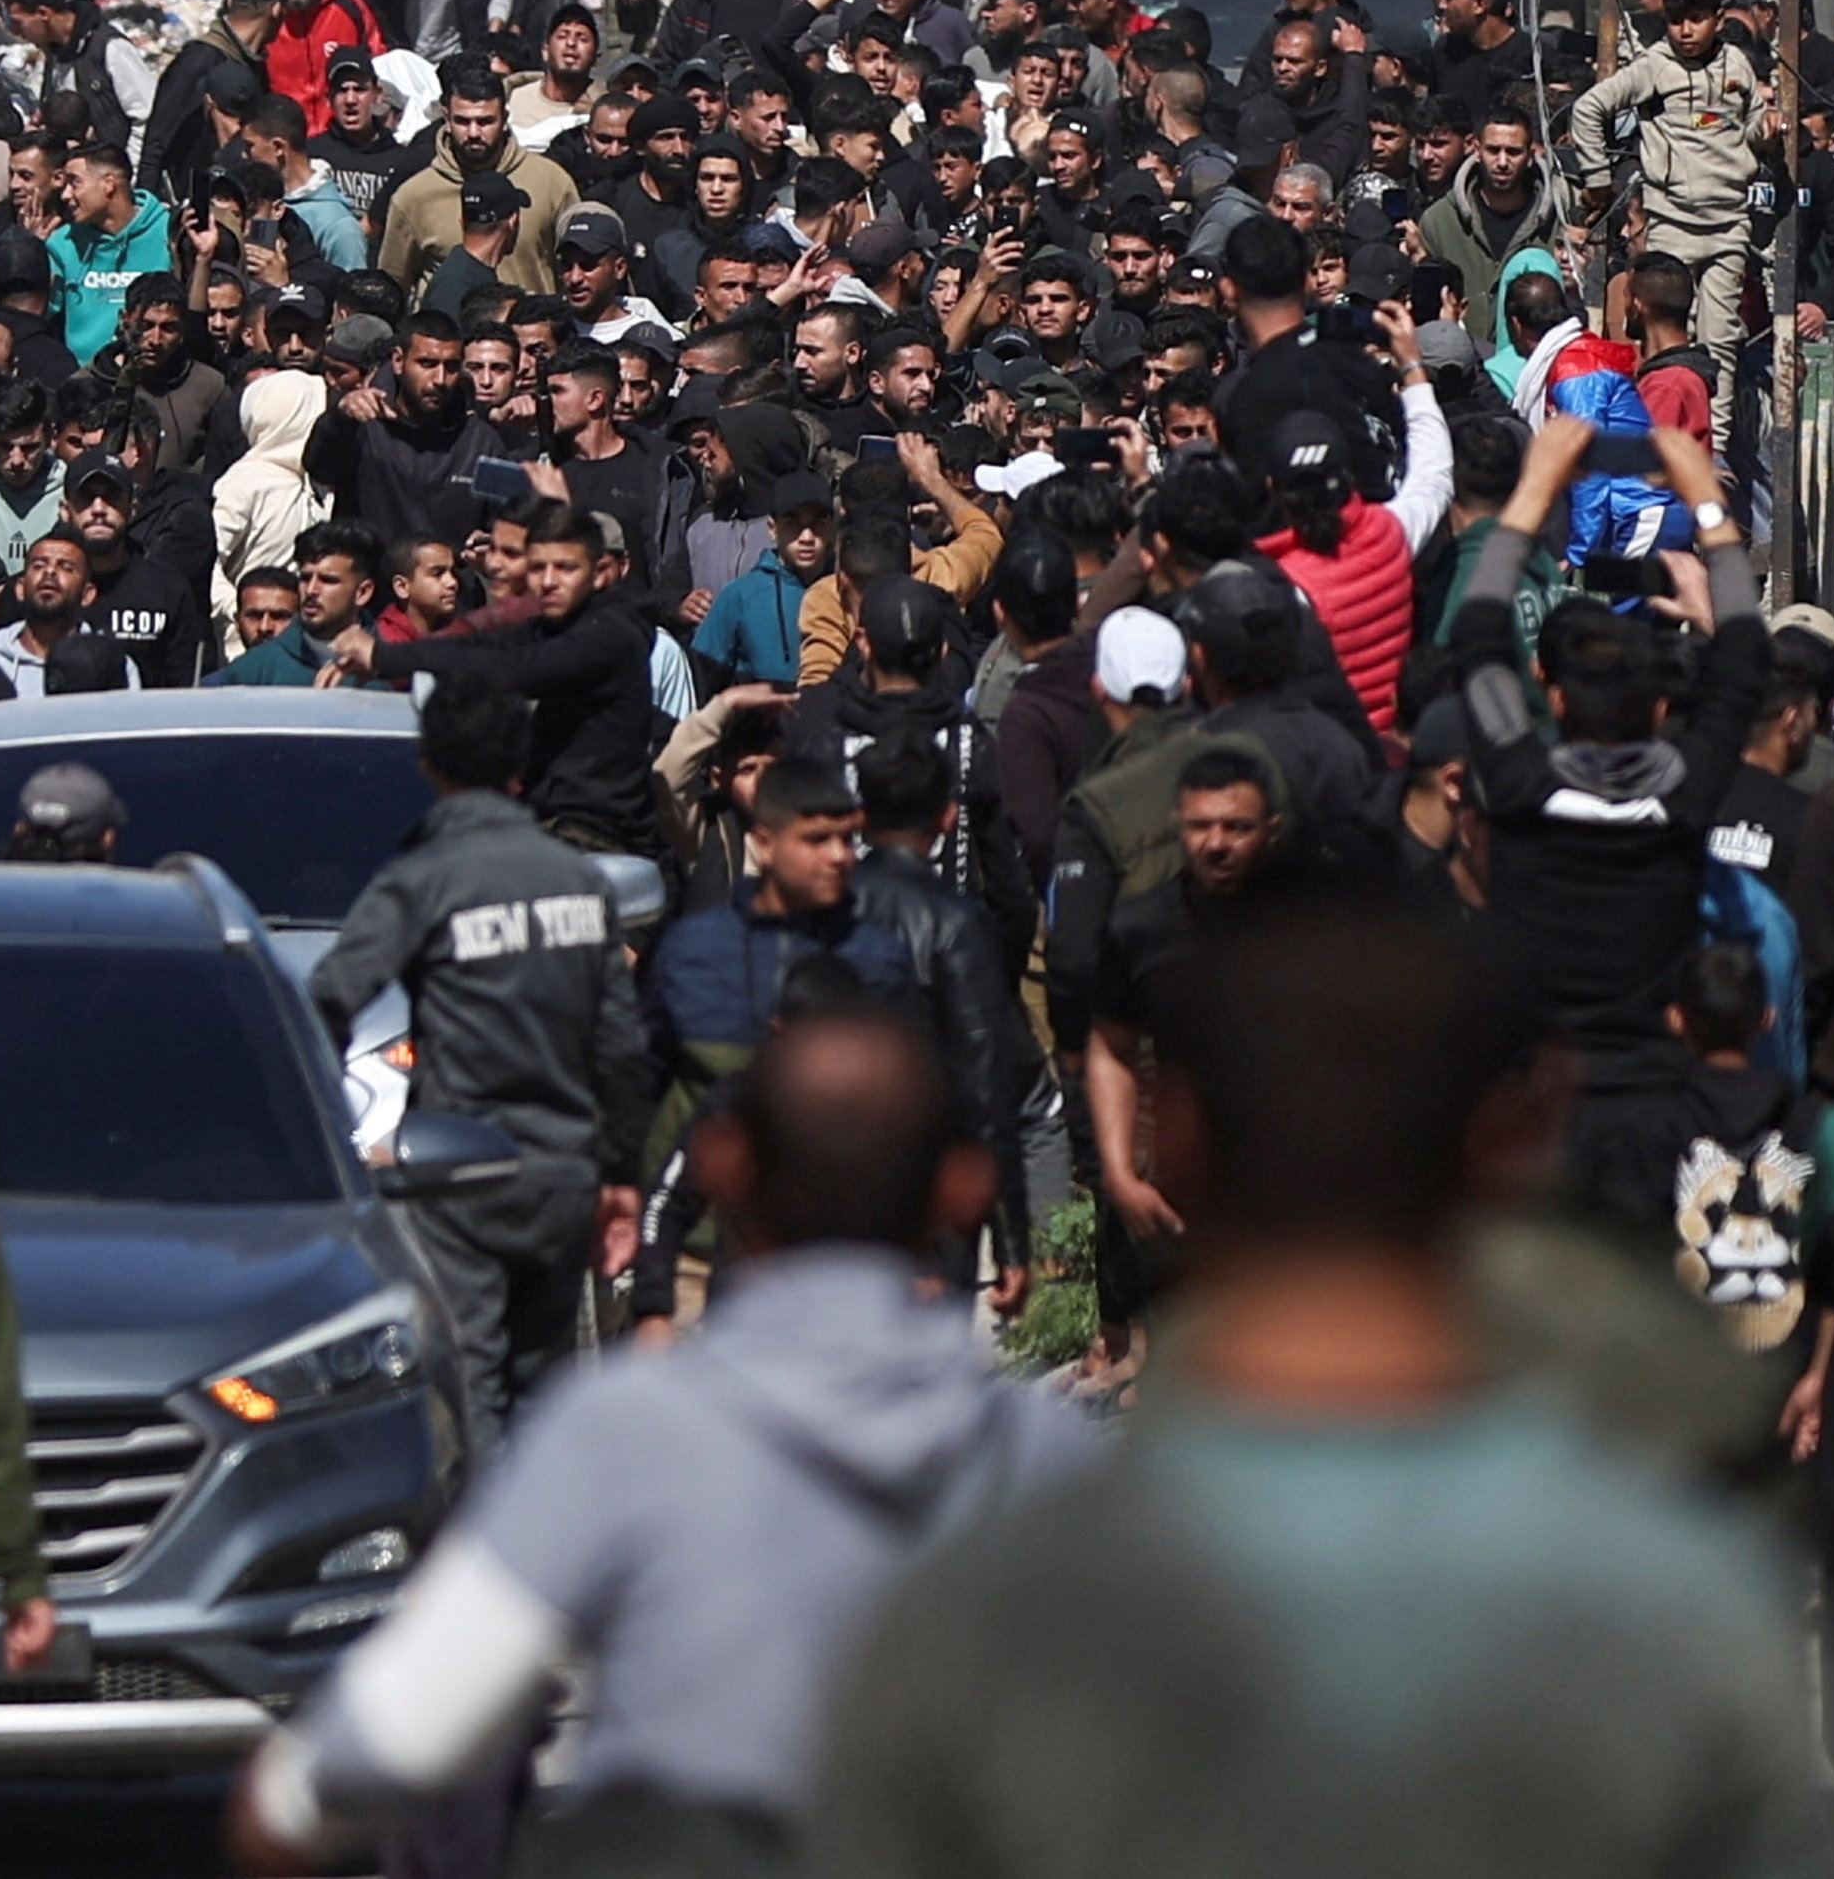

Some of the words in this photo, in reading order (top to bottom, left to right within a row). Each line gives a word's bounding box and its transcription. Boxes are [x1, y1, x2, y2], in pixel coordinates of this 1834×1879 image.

[111, 609, 168, 634] ICON
[449, 900, 529, 962] NEW
[532, 894, 607, 949] YORK
